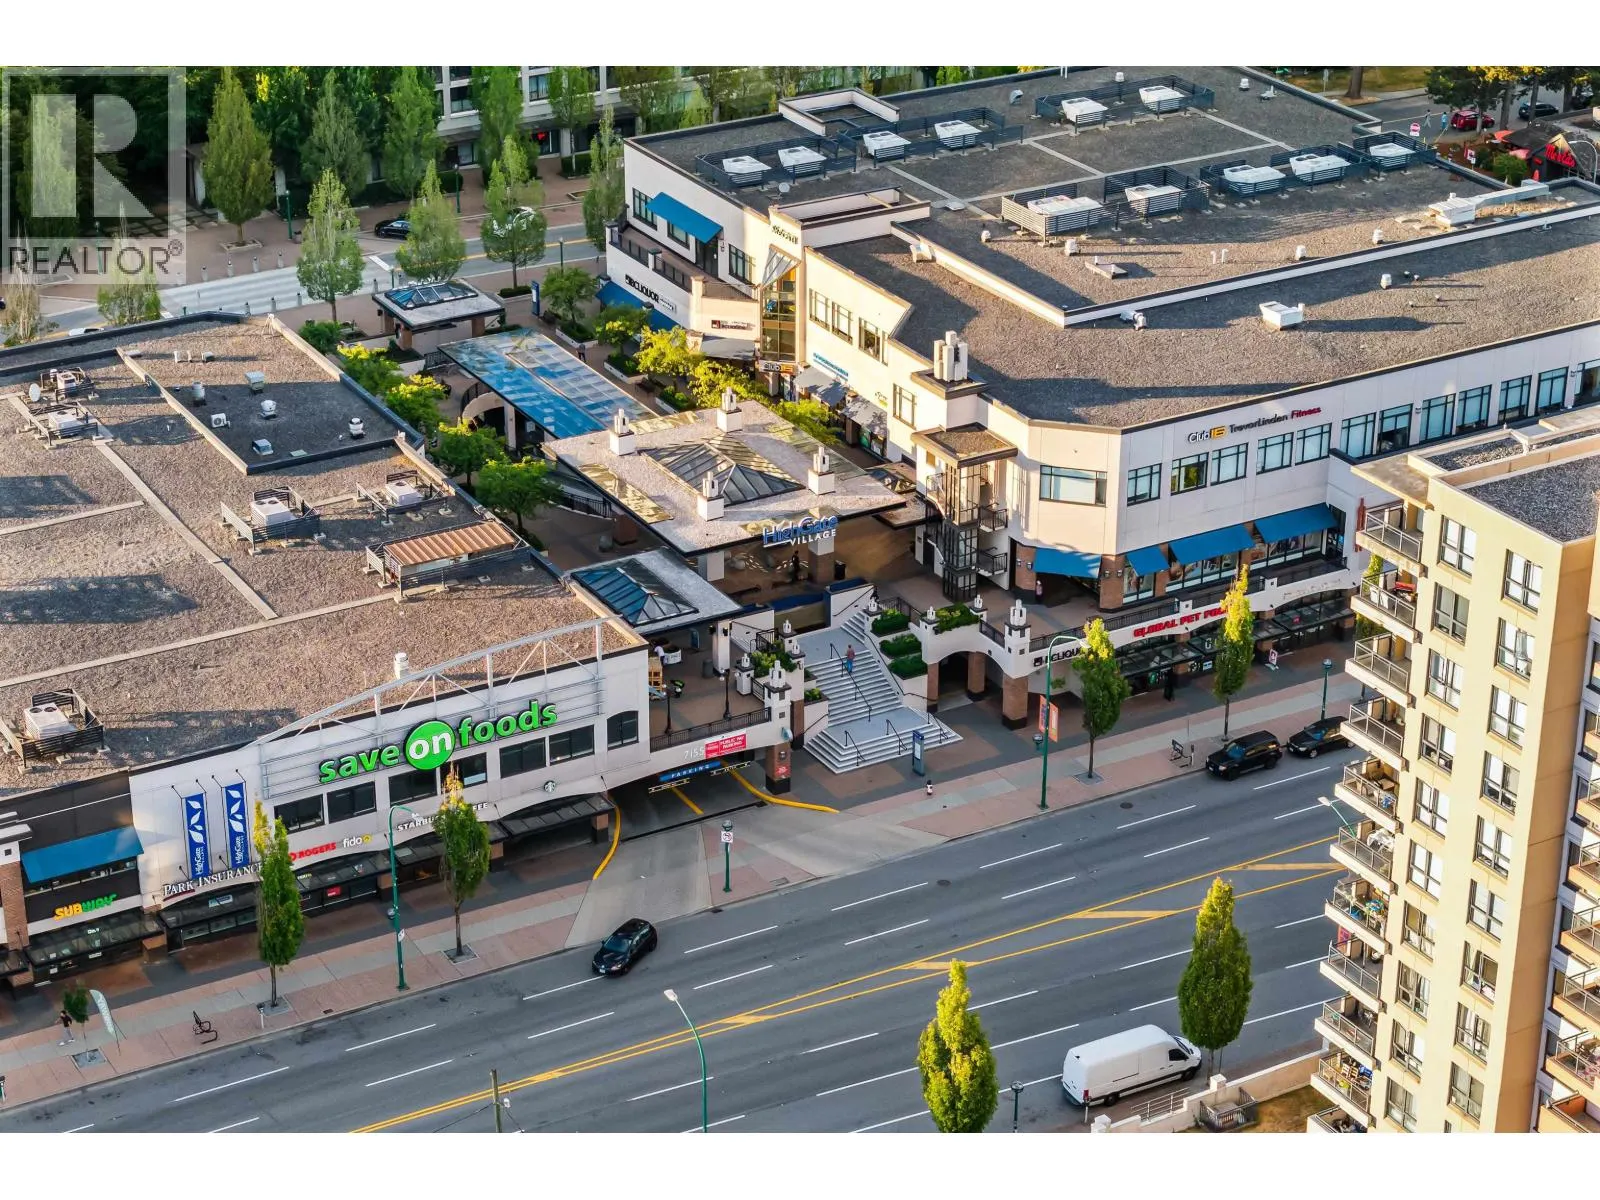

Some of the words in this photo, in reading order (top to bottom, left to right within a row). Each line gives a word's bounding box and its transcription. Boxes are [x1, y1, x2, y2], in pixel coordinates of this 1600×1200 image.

[1290, 406, 1322, 420] Fitness
[763, 516, 839, 545] HighGate
[789, 529, 837, 547] VILLAGE
[1133, 619, 1178, 638] GLOBAL
[1180, 612, 1201, 625] PET
[318, 743, 401, 784] save
[408, 729, 453, 762] on
[457, 699, 559, 748] foods
[684, 746, 706, 760] 7155
[298, 842, 337, 858] ROGERS
[343, 836, 363, 848] fido
[162, 880, 196, 897] PARK
[53, 893, 118, 921] SUBWAY
